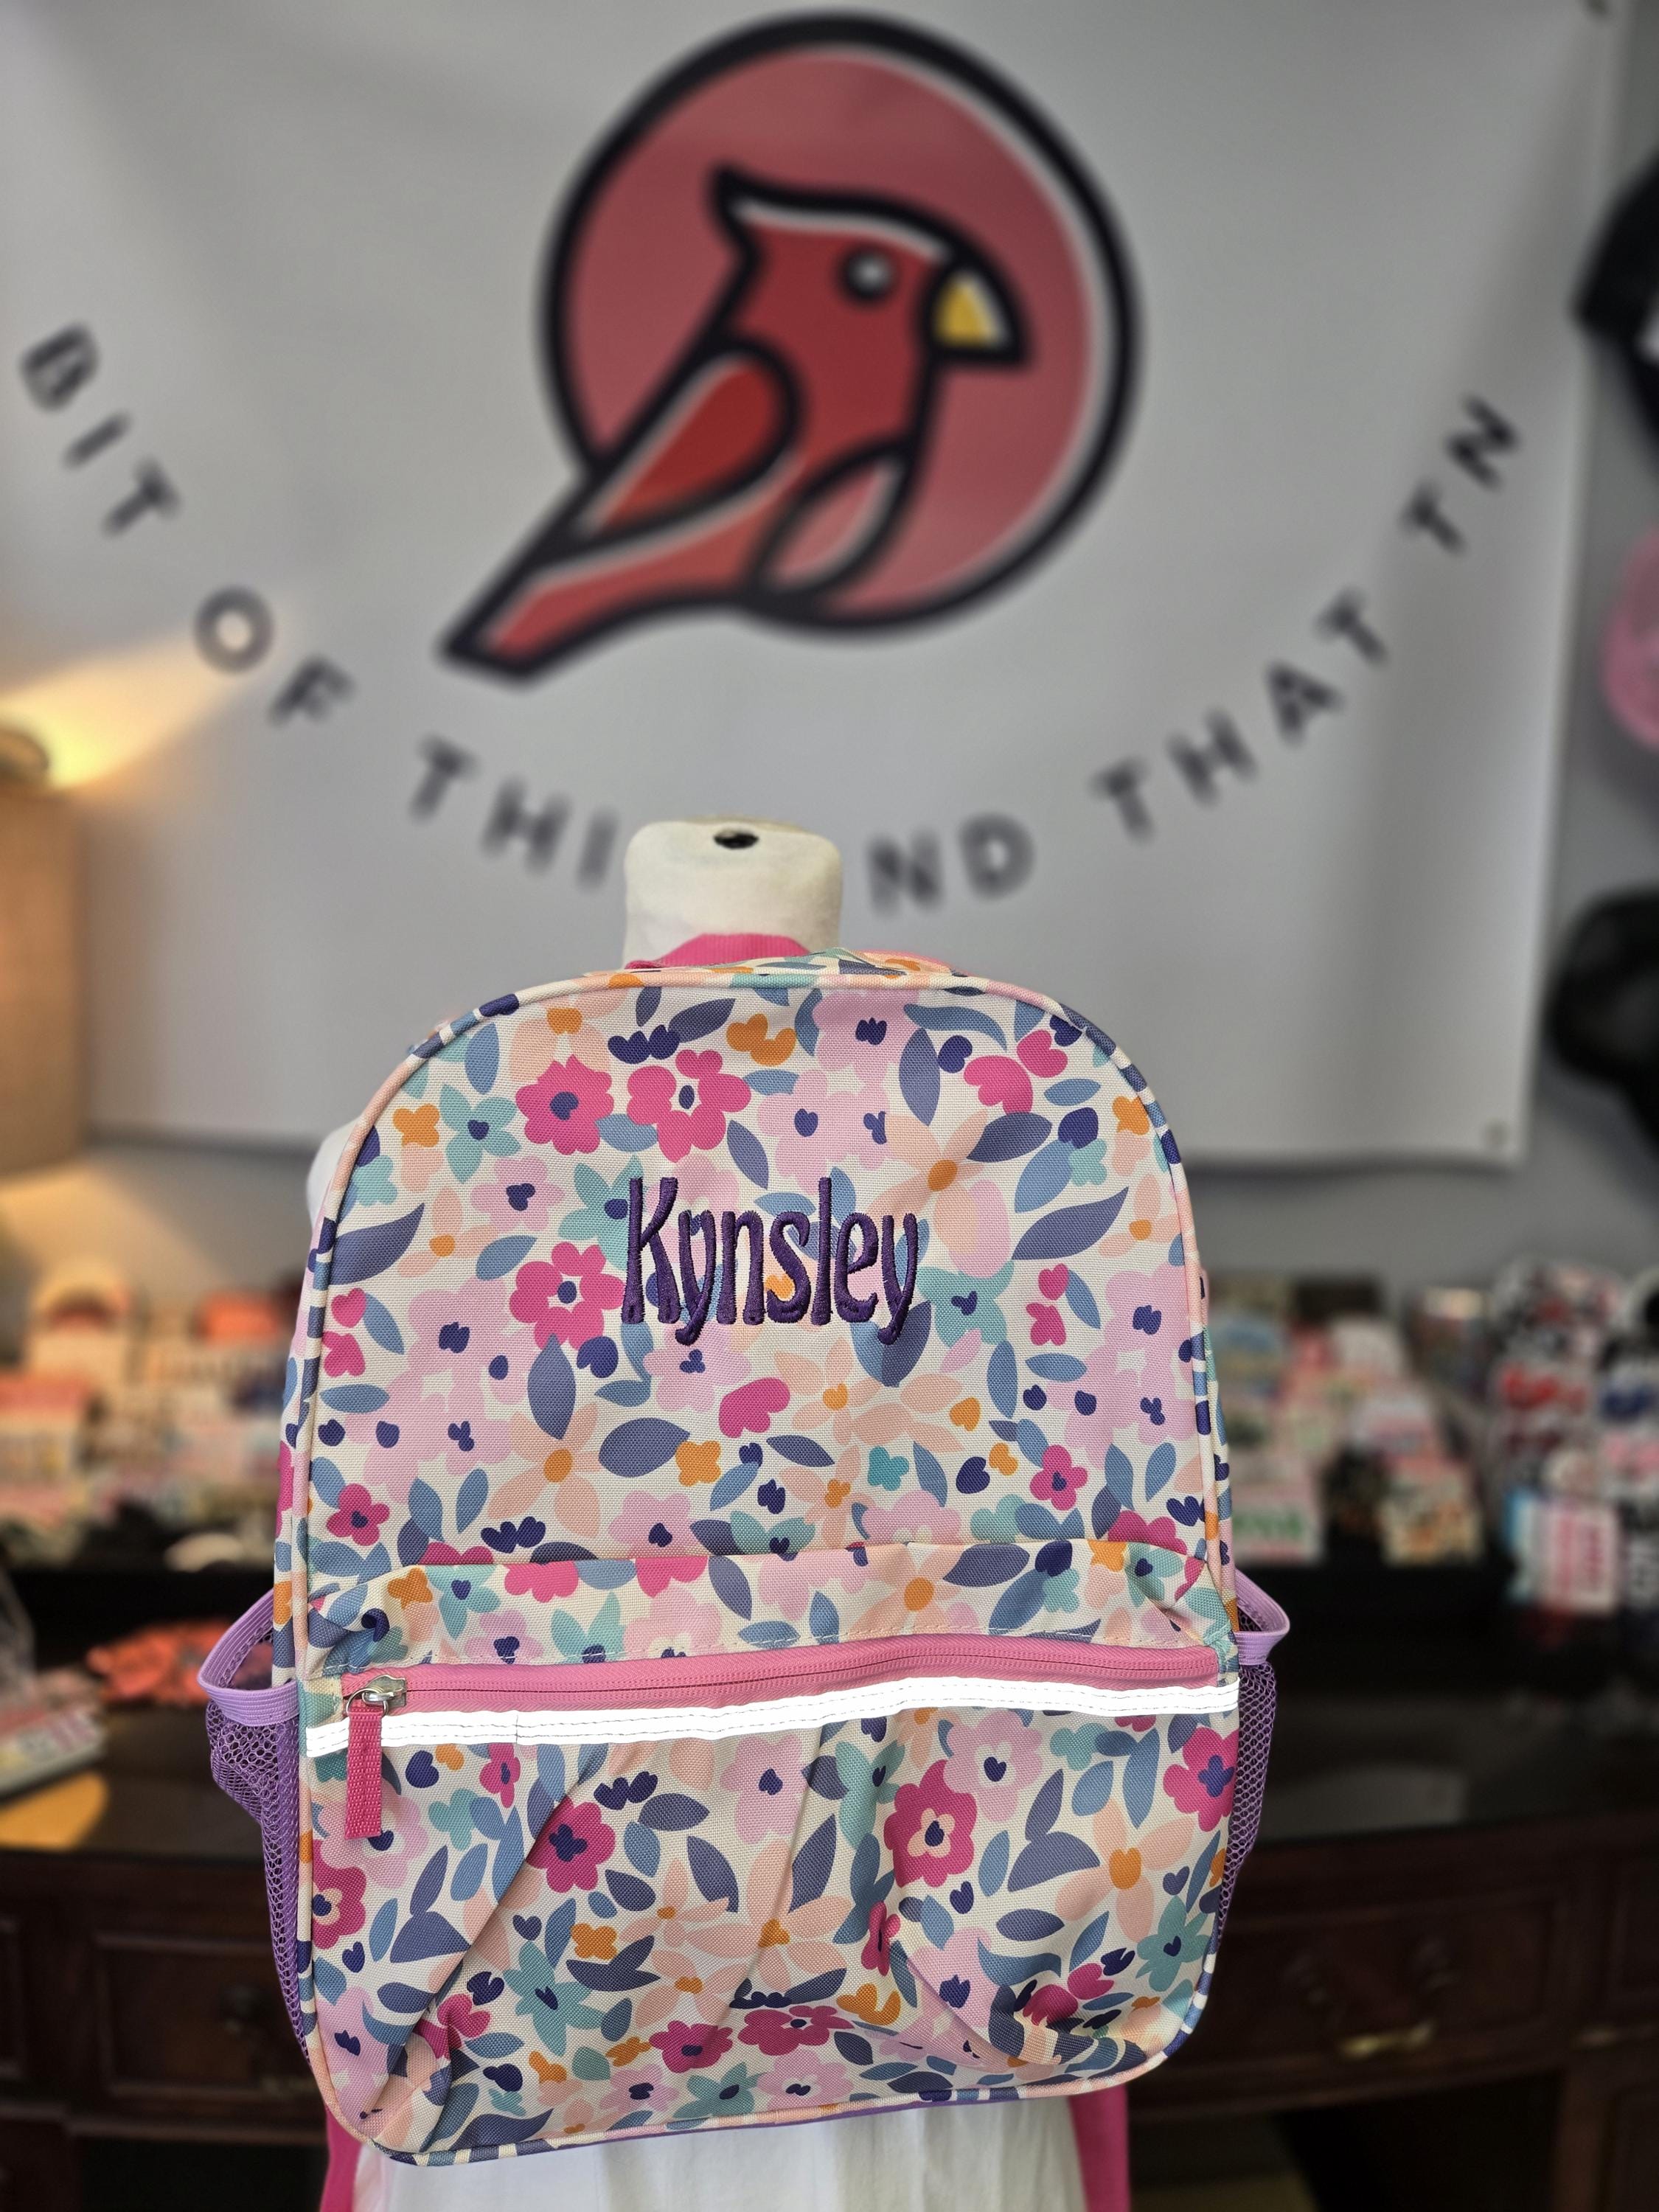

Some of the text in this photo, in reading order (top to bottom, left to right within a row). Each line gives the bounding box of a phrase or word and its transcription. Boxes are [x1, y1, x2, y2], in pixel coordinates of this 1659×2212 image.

[21, 321, 1521, 918] BIT OF THI ND THAT TN
[621, 1177, 919, 1346] Kynsley
